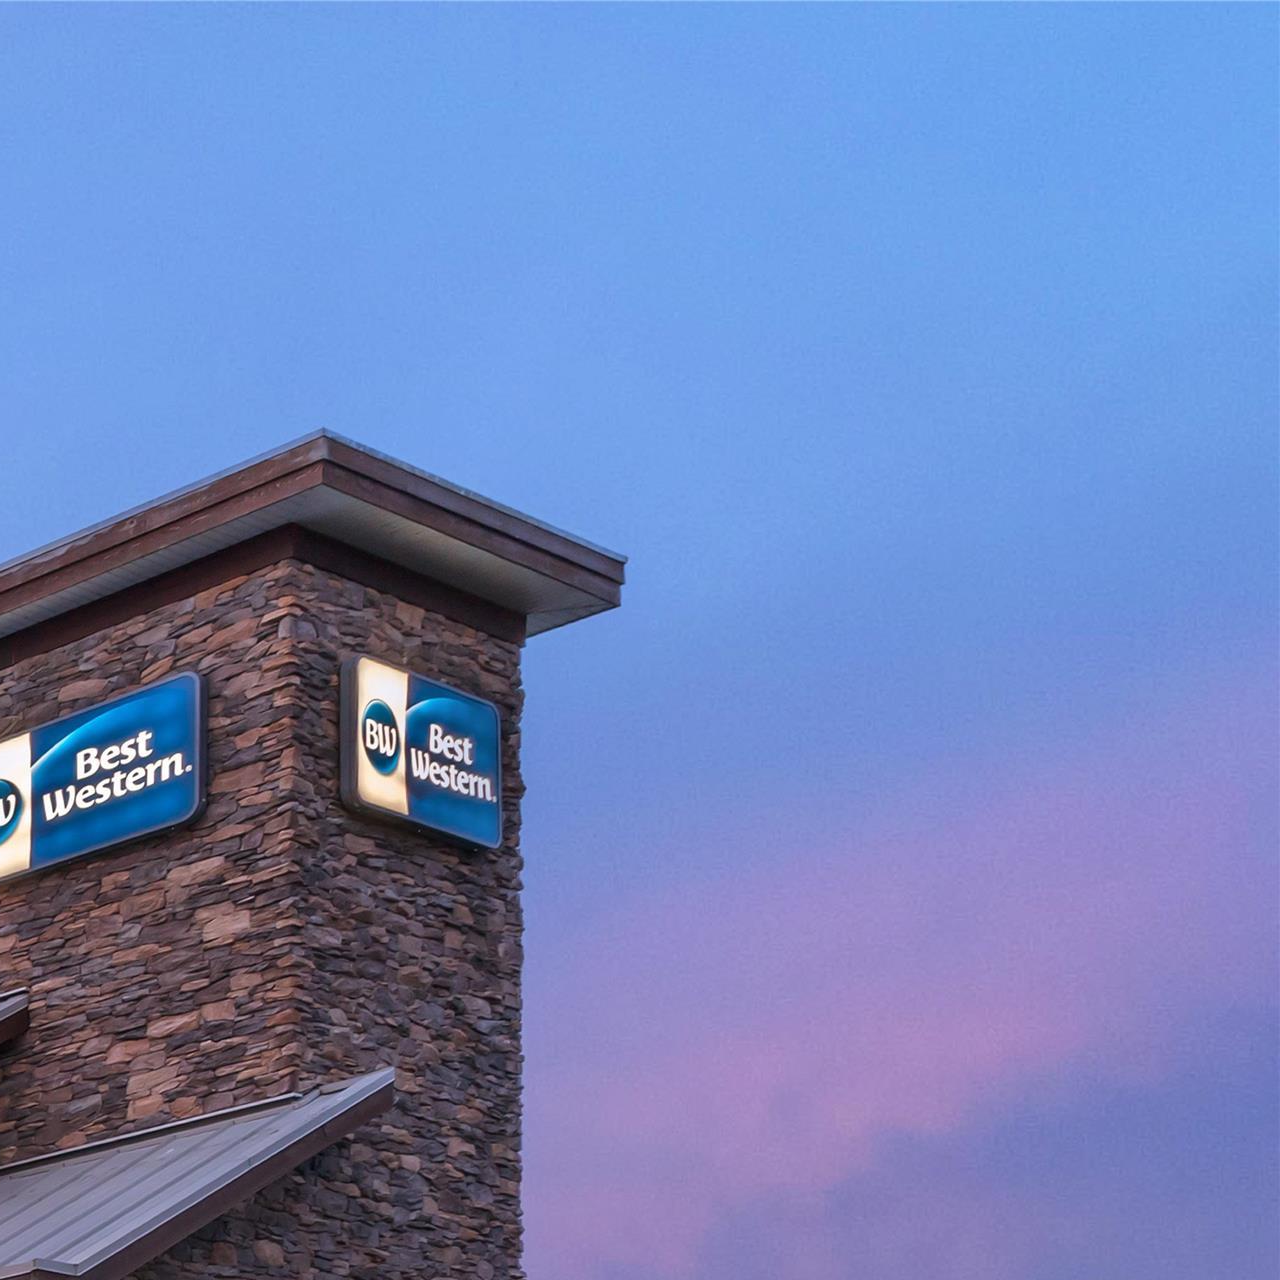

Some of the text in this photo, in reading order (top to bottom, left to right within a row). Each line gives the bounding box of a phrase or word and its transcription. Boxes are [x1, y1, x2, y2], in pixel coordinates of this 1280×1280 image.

[76, 729, 153, 780] Best
[365, 718, 397, 757] BW
[429, 723, 473, 765] Best
